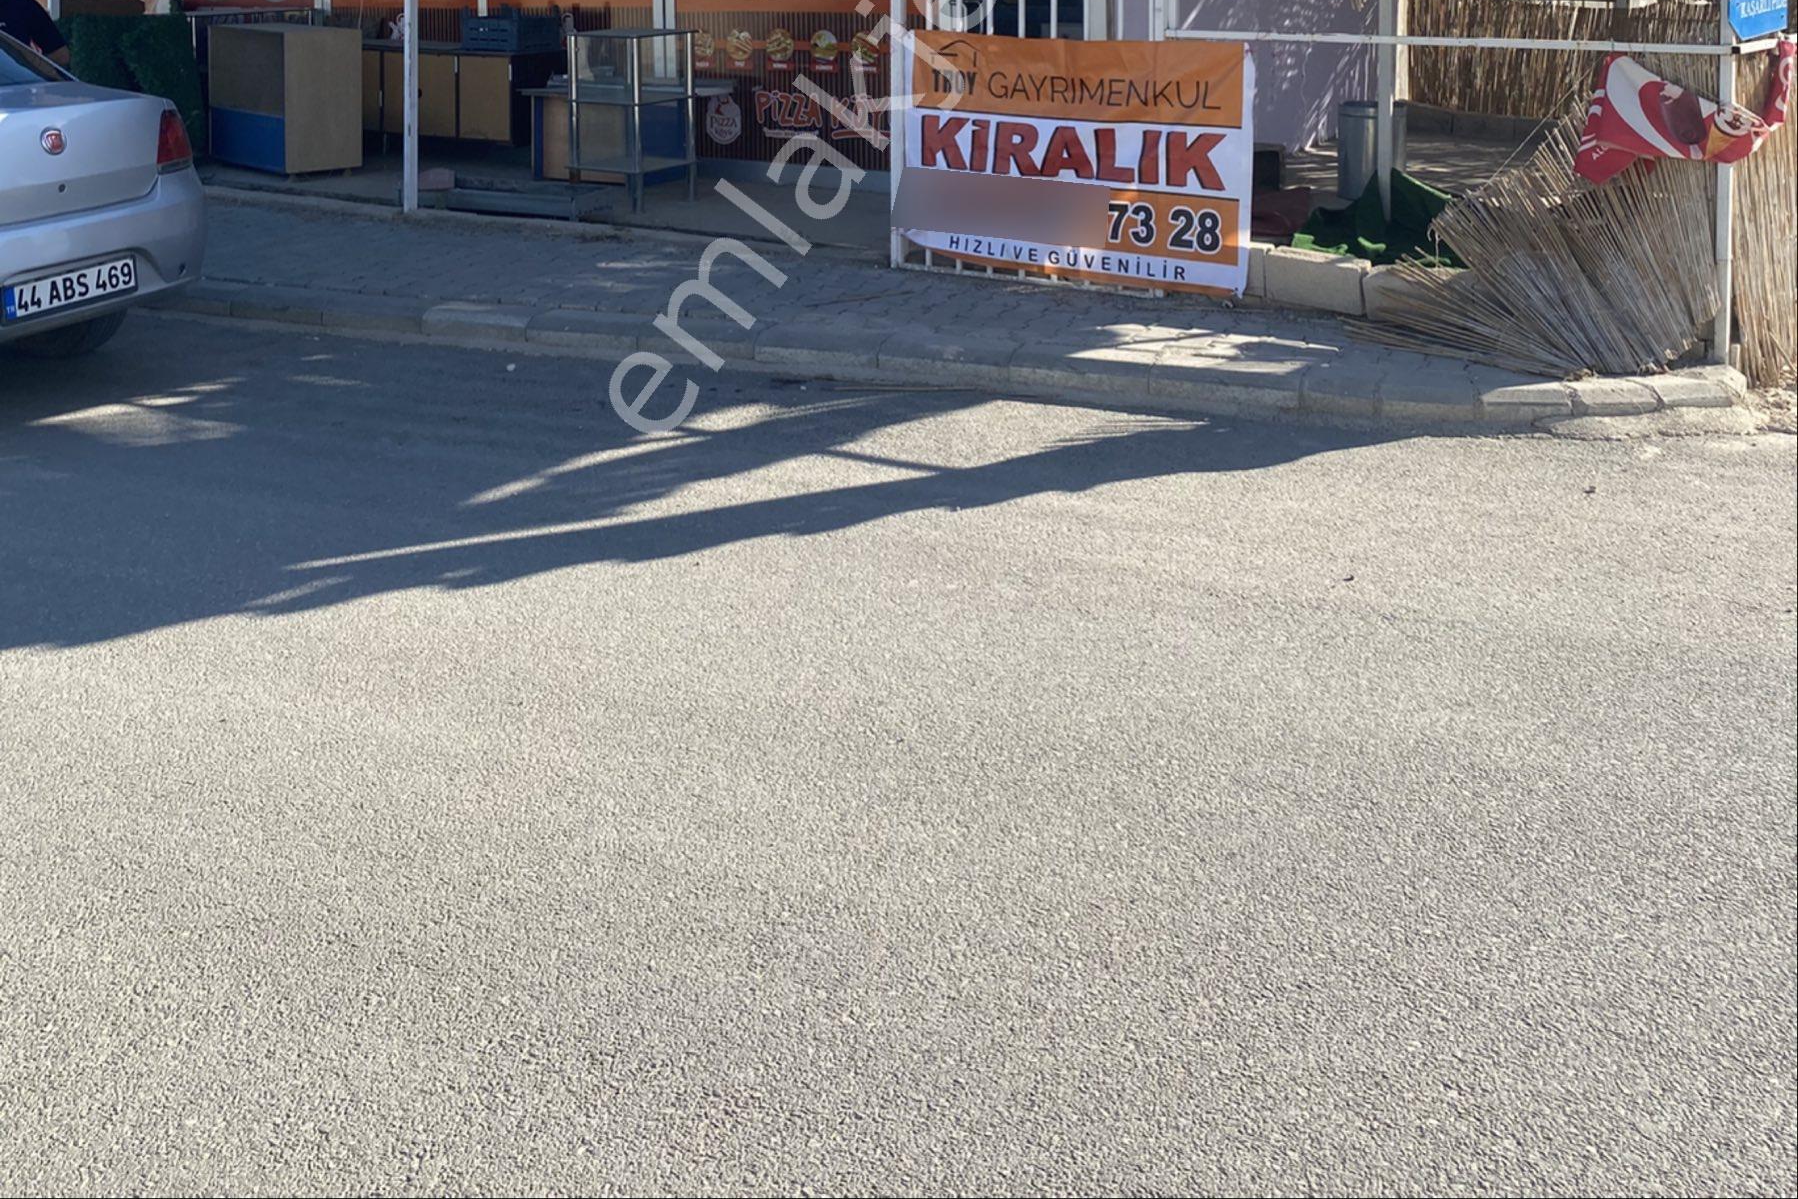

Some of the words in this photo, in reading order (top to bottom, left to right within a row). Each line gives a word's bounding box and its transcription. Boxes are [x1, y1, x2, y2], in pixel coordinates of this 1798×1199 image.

[931, 68, 978, 96] TROY
[987, 71, 1221, 110] GAYRIMENKUL
[831, 94, 890, 148] KÖY
[921, 114, 1226, 191] KİRALIK
[1108, 201, 1156, 246] 73
[1167, 206, 1222, 254] 28
[950, 235, 1004, 257] HIZLI
[1013, 246, 1038, 262] VE
[1048, 246, 1186, 281] GÜVENİLİR
[18, 285, 41, 312] 44
[49, 273, 89, 305] ABS
[95, 262, 133, 291] 469
